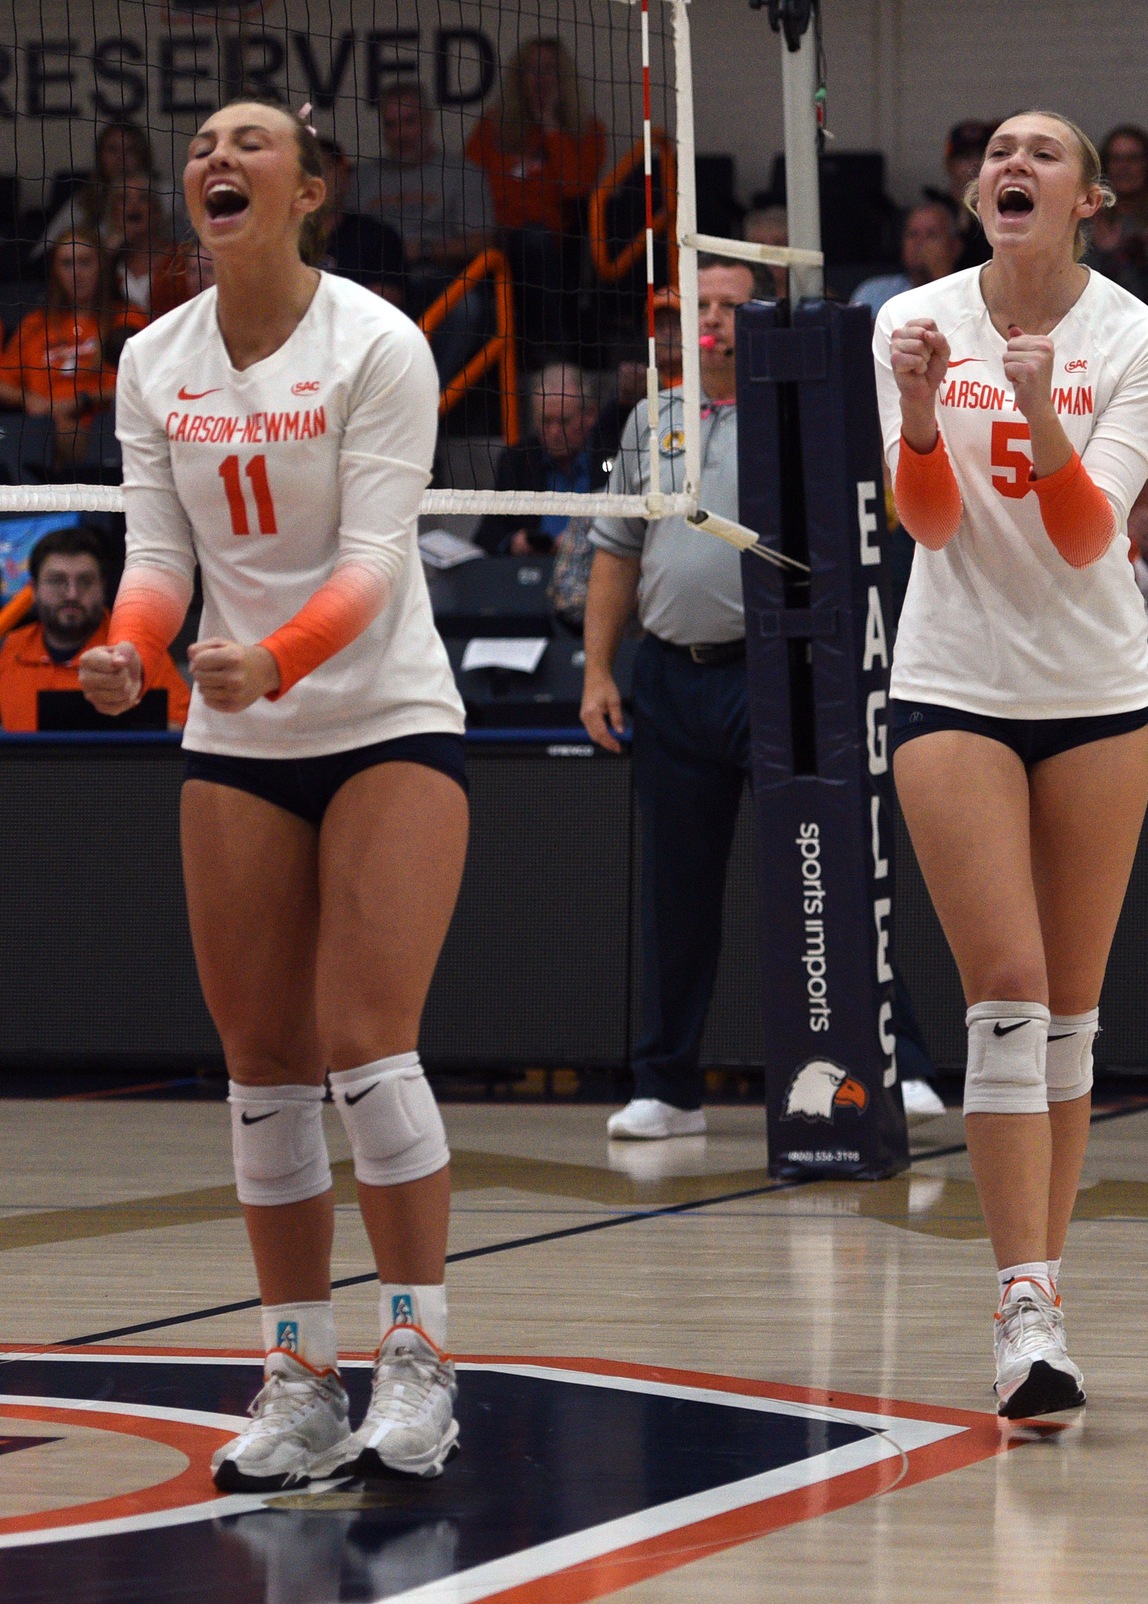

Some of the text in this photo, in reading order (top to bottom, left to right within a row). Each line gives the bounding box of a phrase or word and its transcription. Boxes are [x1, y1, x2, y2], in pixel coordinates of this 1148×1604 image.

[0, 27, 497, 119] ESERVED
[166, 405, 326, 443] CARSON-NEWMAN
[292, 381, 320, 393] SAC
[937, 378, 1093, 416] CARSON-MAN
[218, 455, 278, 535] 11
[990, 421, 1034, 499] 5
[857, 480, 897, 1088] EAGLES
[796, 822, 832, 1032] sports imports
